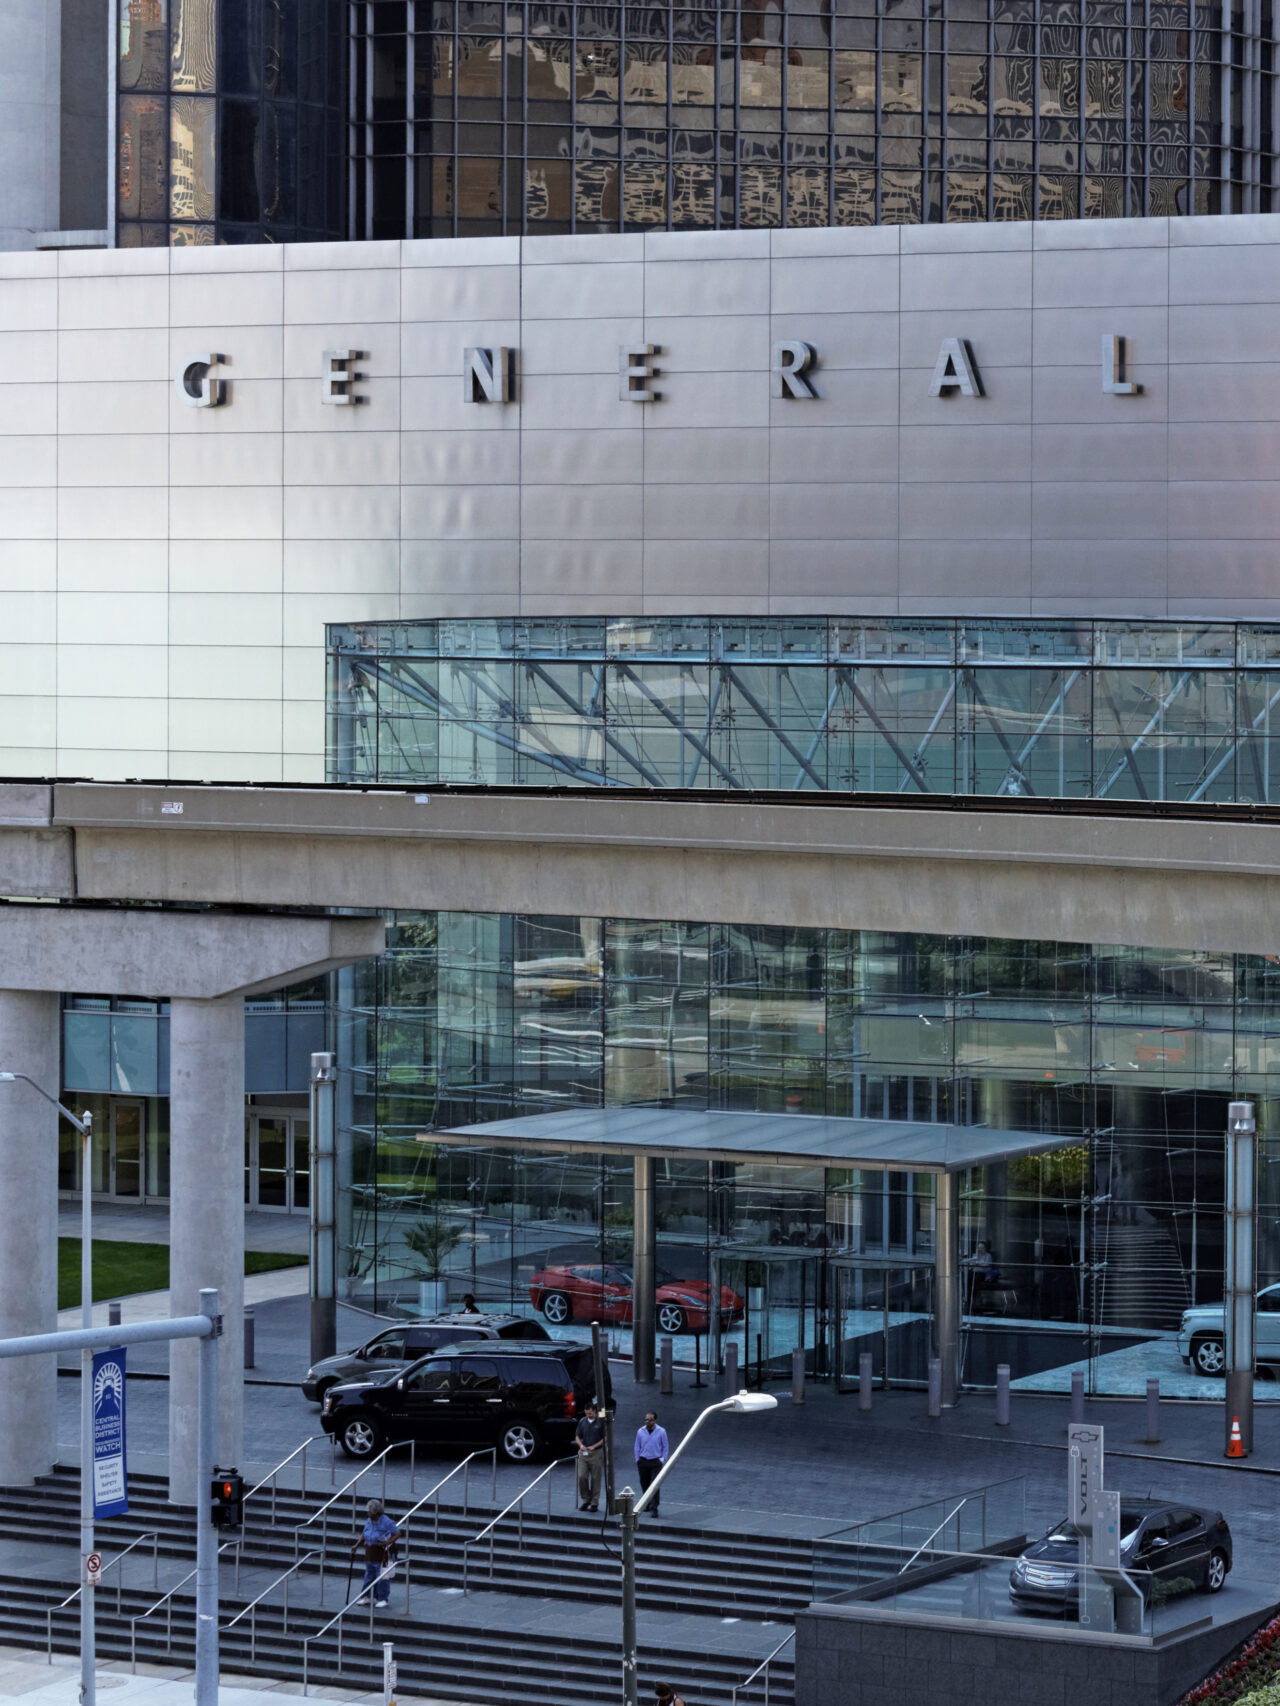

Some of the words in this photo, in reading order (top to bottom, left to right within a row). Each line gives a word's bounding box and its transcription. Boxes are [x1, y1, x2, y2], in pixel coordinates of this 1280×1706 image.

[173, 334, 1143, 409] GENERAL
[96, 1414, 120, 1425] CENTRAL
[95, 1427, 120, 1439] DISTRICT
[96, 1441, 120, 1453] WATCH
